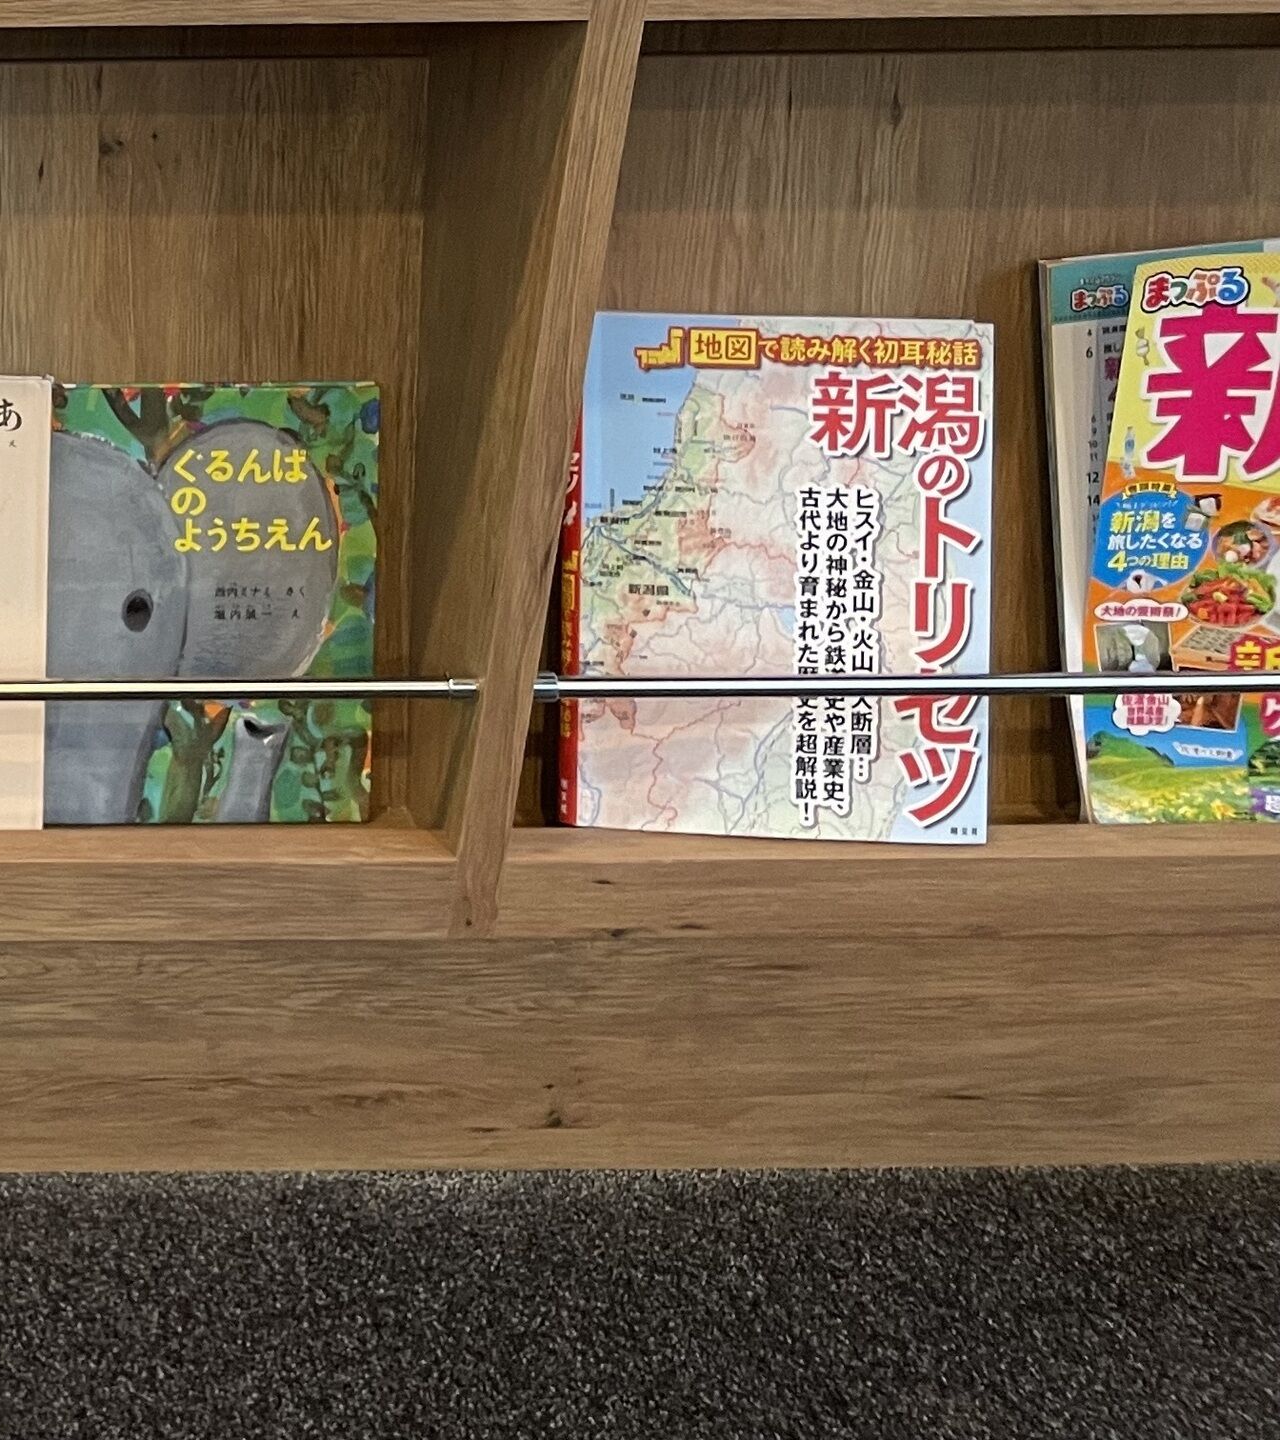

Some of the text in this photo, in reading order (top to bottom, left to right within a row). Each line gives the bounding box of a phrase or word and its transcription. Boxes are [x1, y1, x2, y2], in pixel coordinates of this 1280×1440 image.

[1072, 285, 1129, 310] まっぷる
[1142, 269, 1249, 308] まっぷる
[694, 331, 979, 366] 地図で読み解く初耳秘話
[810, 373, 982, 455] 新潟
[1086, 471, 1100, 484] 12
[171, 486, 207, 517] の
[174, 516, 333, 553] ようちえん
[1110, 509, 1177, 533] 新潟を
[1107, 532, 1203, 551] 旅したくなる
[1107, 550, 1189, 572] 4つの理由
